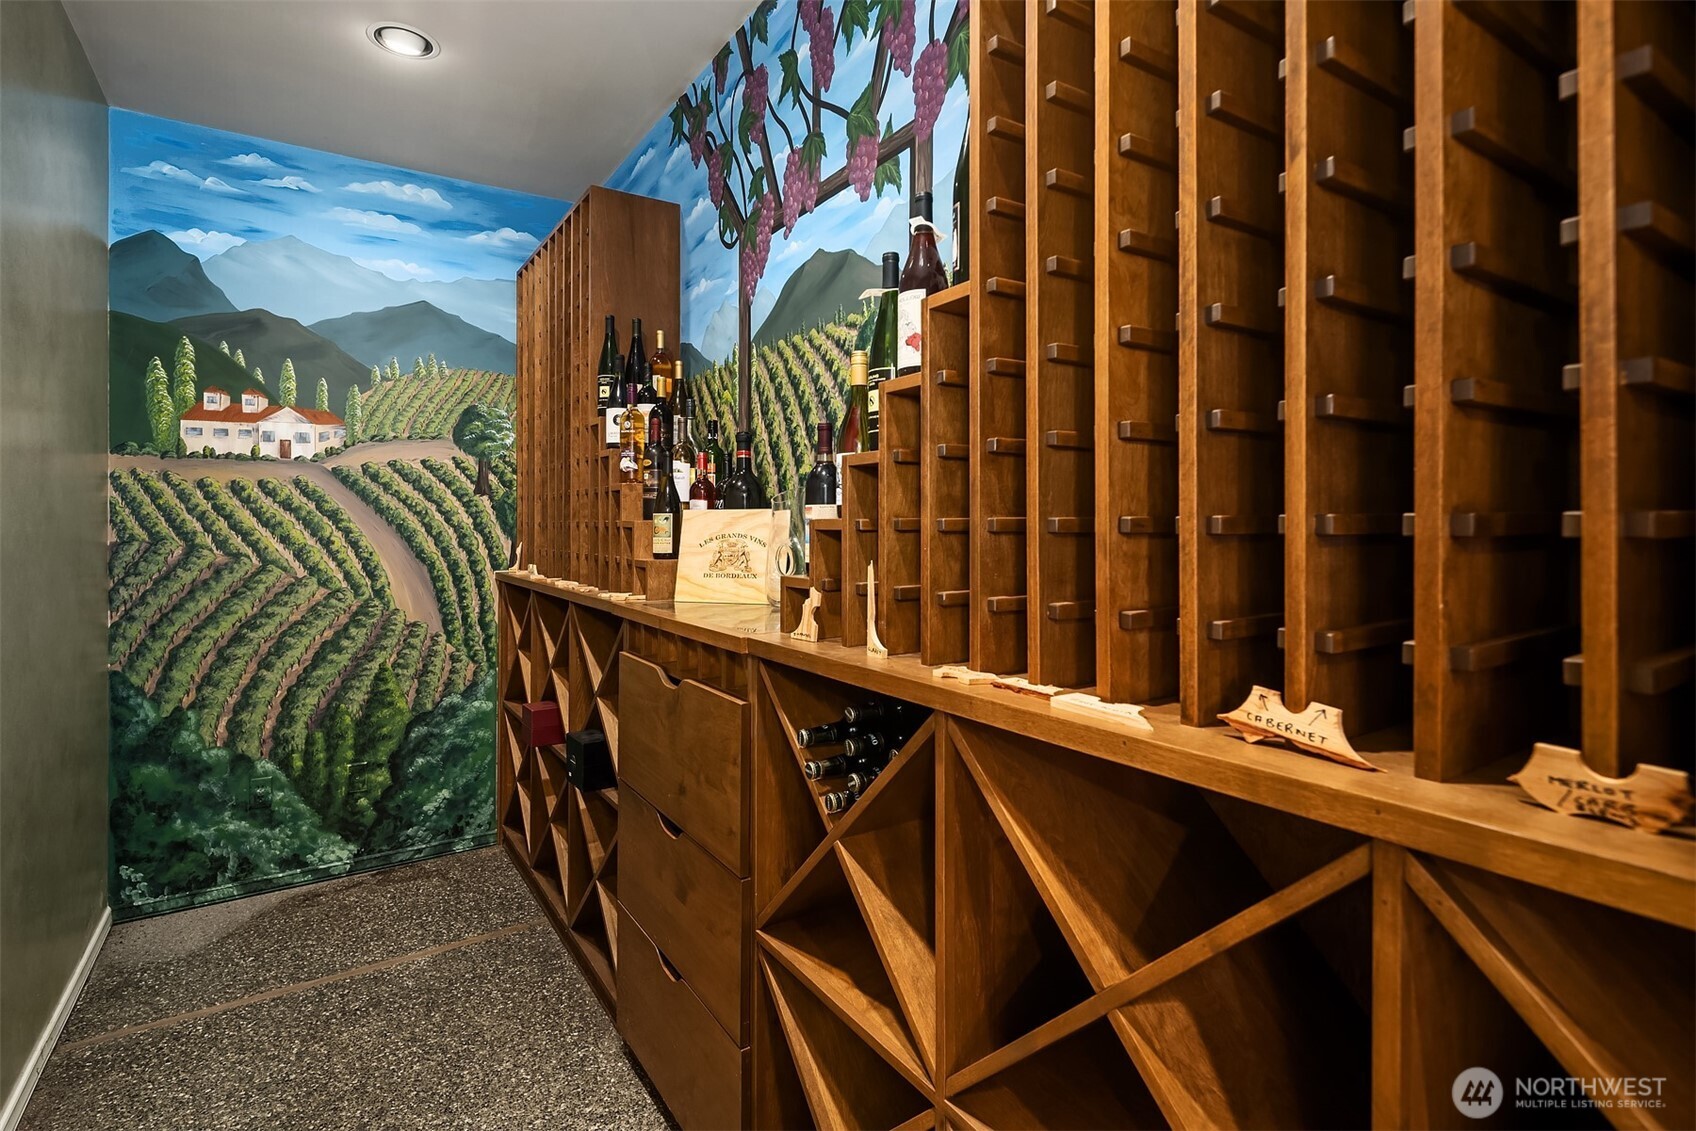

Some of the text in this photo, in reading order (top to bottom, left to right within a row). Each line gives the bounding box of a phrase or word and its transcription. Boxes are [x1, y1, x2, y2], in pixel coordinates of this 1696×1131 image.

[699, 537, 714, 548] LES
[749, 534, 767, 548] VINS
[1246, 712, 1328, 745] CABERNET
